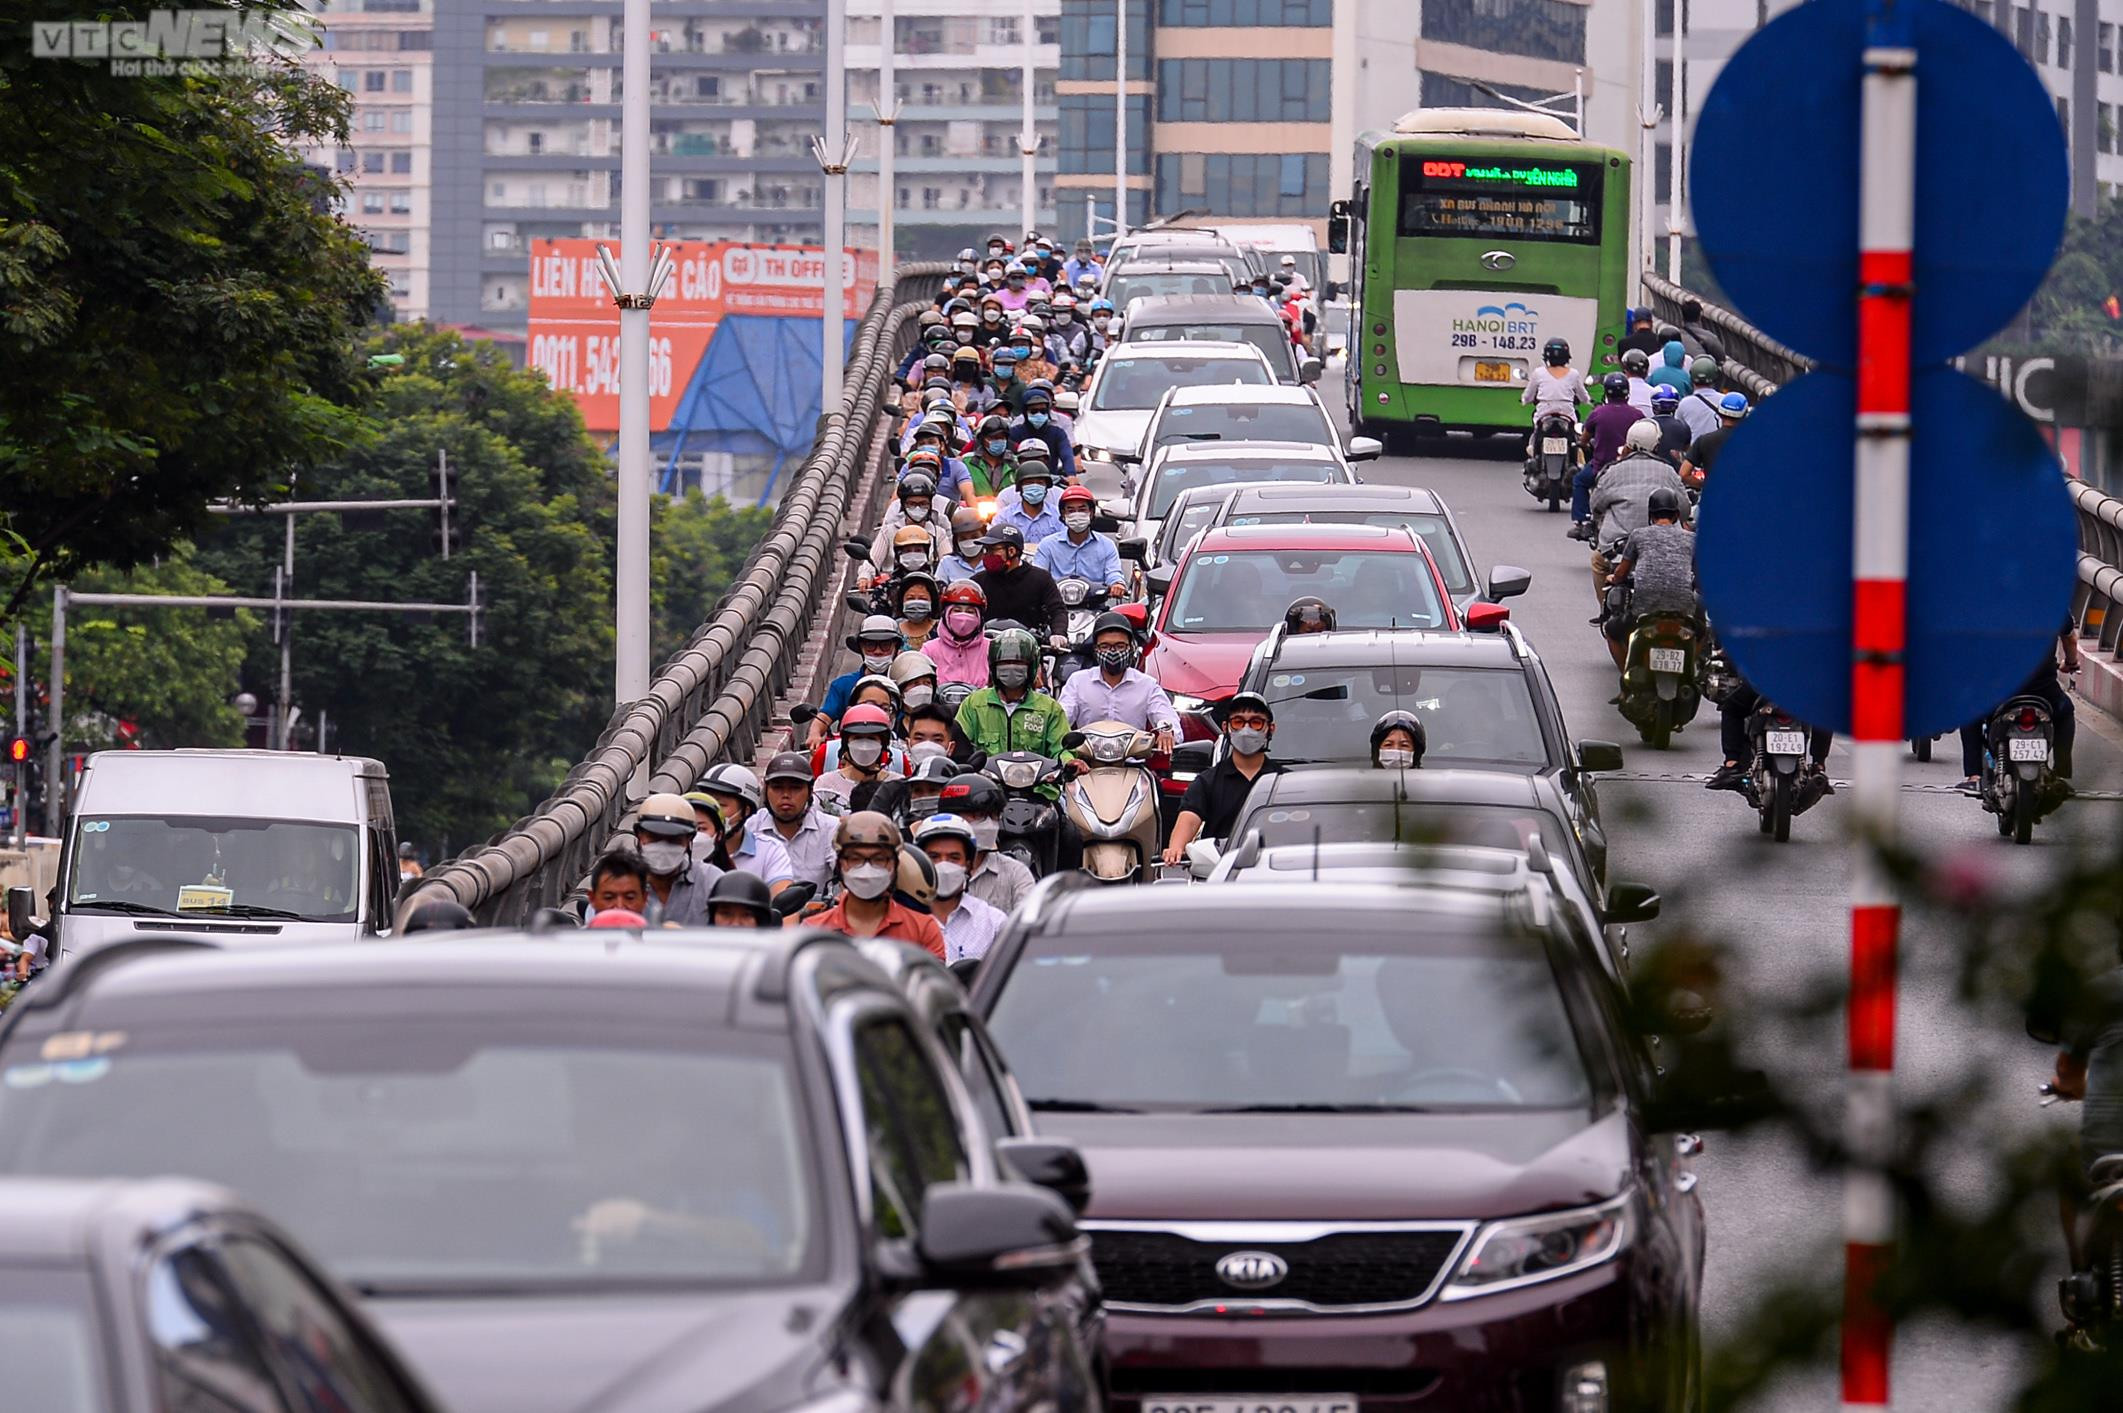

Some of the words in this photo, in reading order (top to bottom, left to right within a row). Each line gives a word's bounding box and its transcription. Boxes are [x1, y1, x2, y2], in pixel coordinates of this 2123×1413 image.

[533, 248, 577, 298] LIÊN
[681, 251, 722, 300] CÁO
[1451, 334, 1477, 347] 29B
[1492, 335, 1536, 350] 148.23
[1023, 721, 1044, 733] Food
[2015, 740, 2041, 750] 29-C1
[1222, 1258, 1279, 1280] KIA
